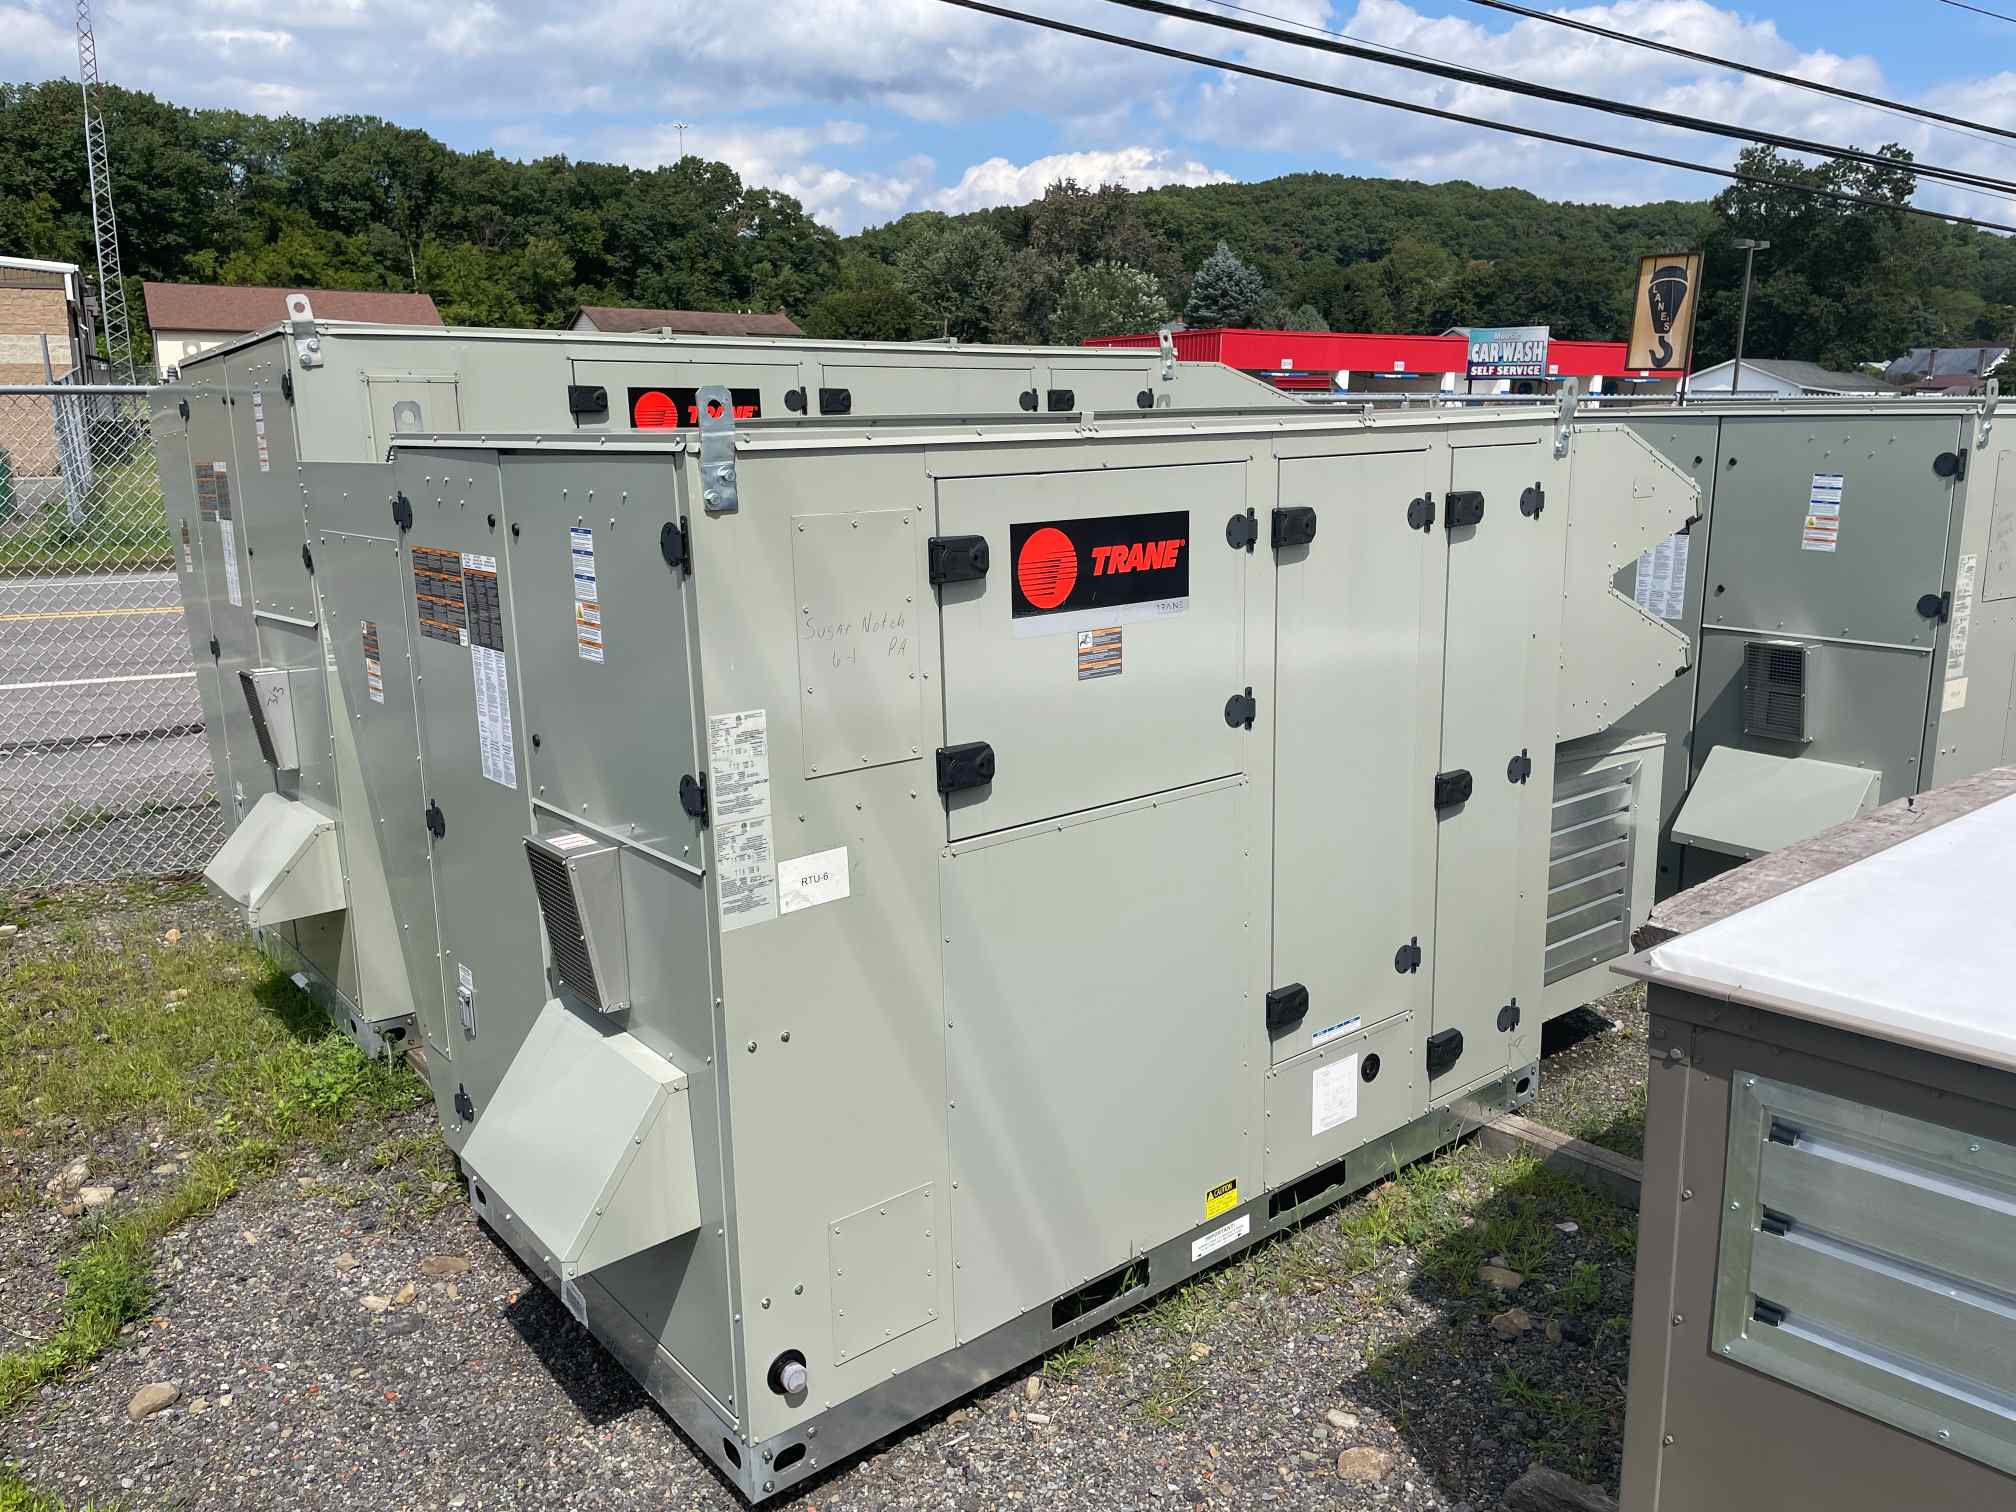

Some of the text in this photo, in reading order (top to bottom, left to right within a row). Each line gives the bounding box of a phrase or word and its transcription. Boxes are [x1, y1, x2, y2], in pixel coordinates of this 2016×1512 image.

[1471, 341, 1544, 363] CAR WASH
[1470, 366, 1494, 376] SELF
[1496, 366, 1540, 376] SERVICE
[1091, 540, 1182, 576] TRANE
[801, 872, 829, 887] RTU-6
[1213, 1182, 1233, 1197] CAUTION
